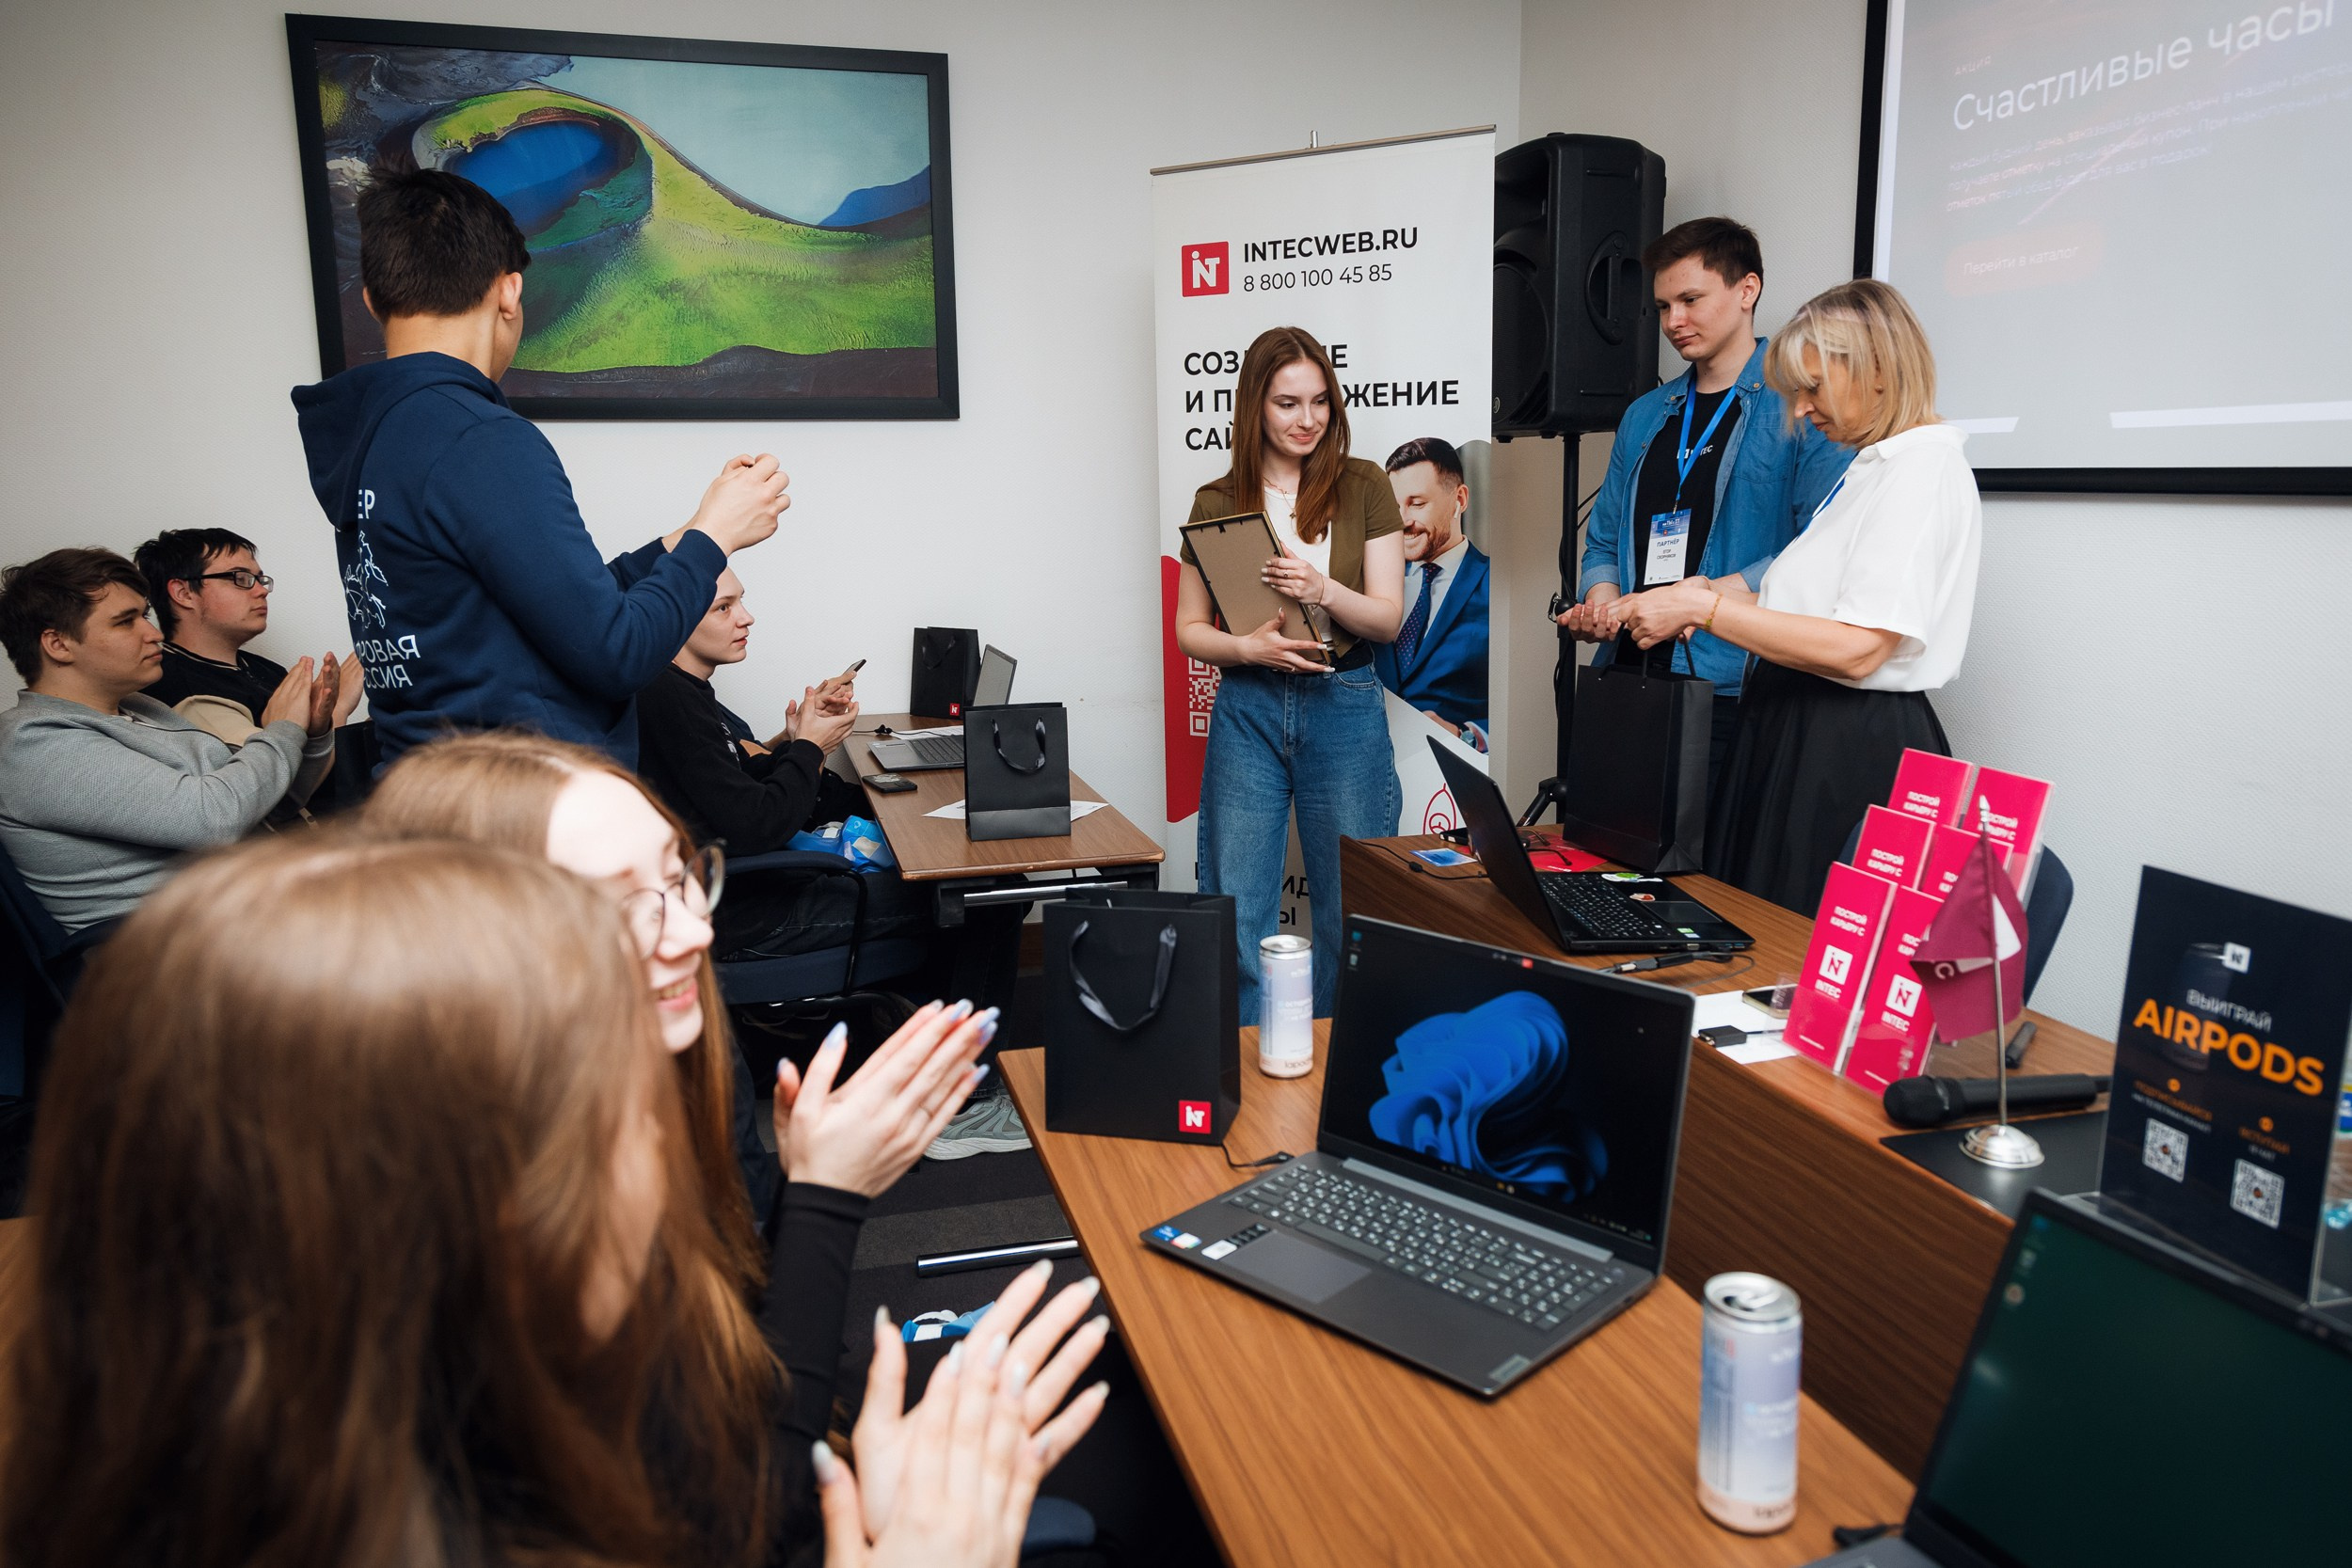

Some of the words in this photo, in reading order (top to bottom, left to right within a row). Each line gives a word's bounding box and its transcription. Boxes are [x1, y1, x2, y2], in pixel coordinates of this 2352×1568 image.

[1953, 35, 2192, 131] Счастливые
[2207, 0, 2335, 56] часы
[1244, 227, 1419, 263] INTECWEB.RU
[1963, 258, 2016, 277] Перейти
[2018, 254, 2027, 268] в
[2029, 245, 2079, 265] каталог
[1244, 275, 1255, 293] 8
[1260, 272, 1296, 291] 800
[1300, 268, 1333, 288] 100
[1340, 265, 1363, 285] 45
[1369, 263, 1392, 282] 85
[1184, 344, 1348, 376] СОЗЕ
[1185, 390, 1203, 413] И
[1214, 379, 1459, 413] ПЖЕНИЕ
[1987, 813, 2018, 829] ОСТРОЙ
[1814, 978, 1842, 1000] INTEC
[1881, 1010, 1909, 1032] INTEC
[2186, 988, 2272, 1033] ВЫИГРАЙ
[2133, 998, 2326, 1097] AIRPODS
